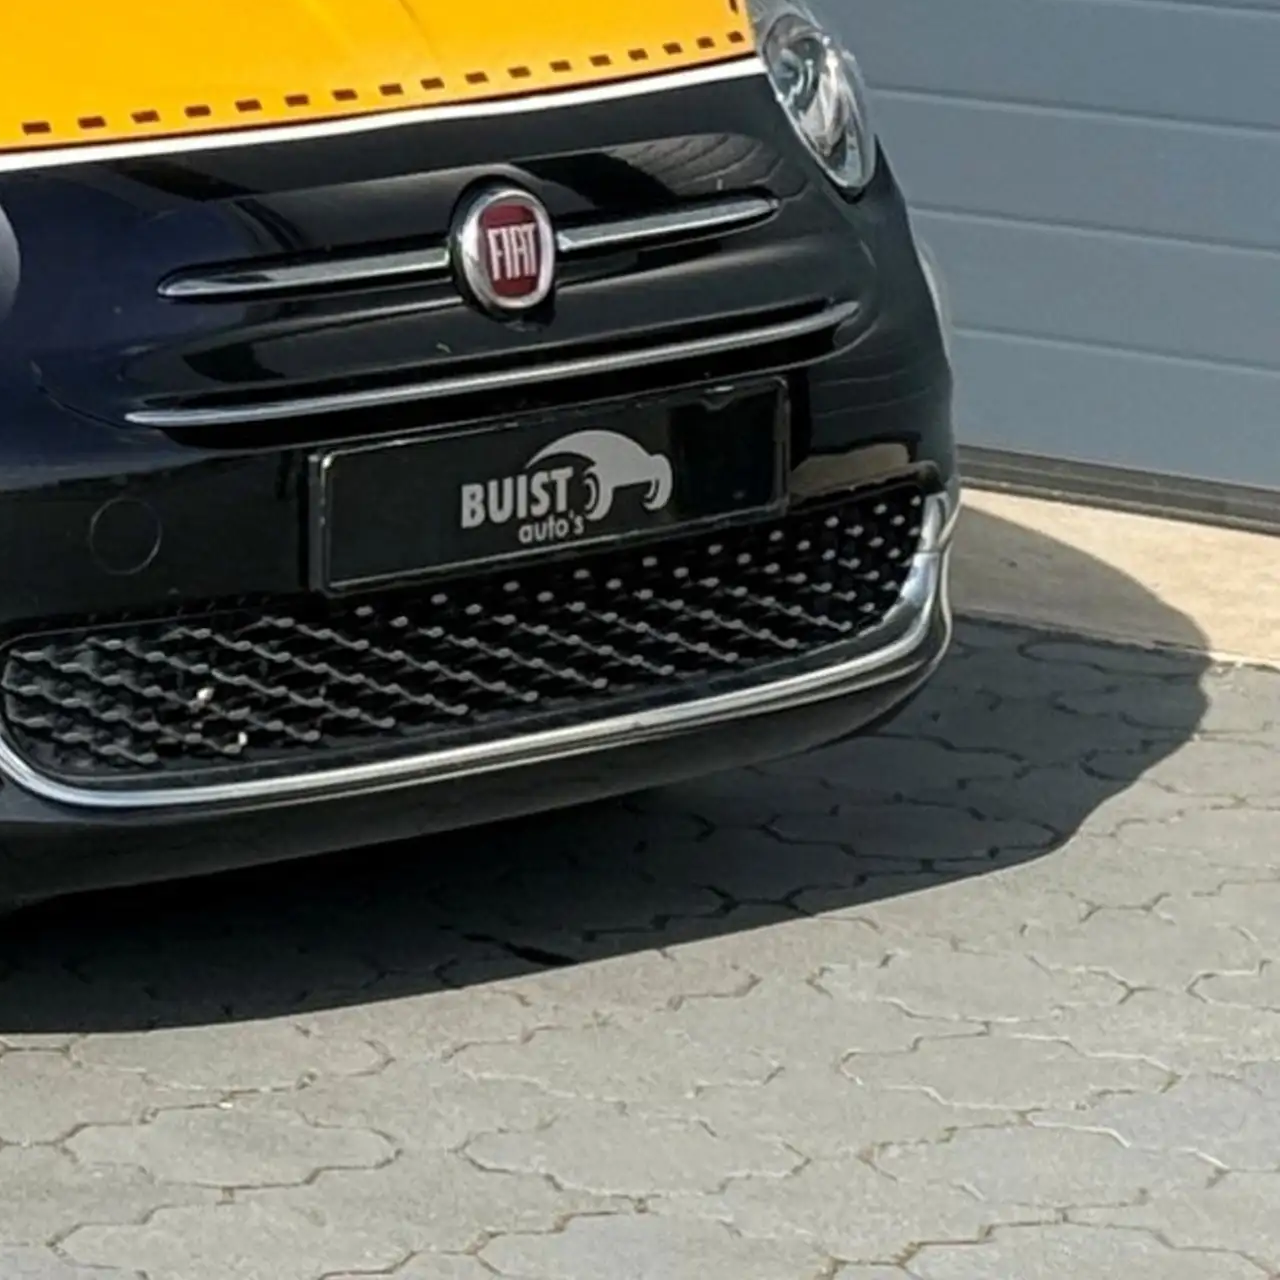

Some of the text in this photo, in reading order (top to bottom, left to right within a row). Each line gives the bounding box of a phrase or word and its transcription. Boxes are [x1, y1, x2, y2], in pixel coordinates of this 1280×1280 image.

[487, 224, 537, 281] FIAT
[461, 467, 573, 528] BUIST
[519, 512, 584, 543] auto's
